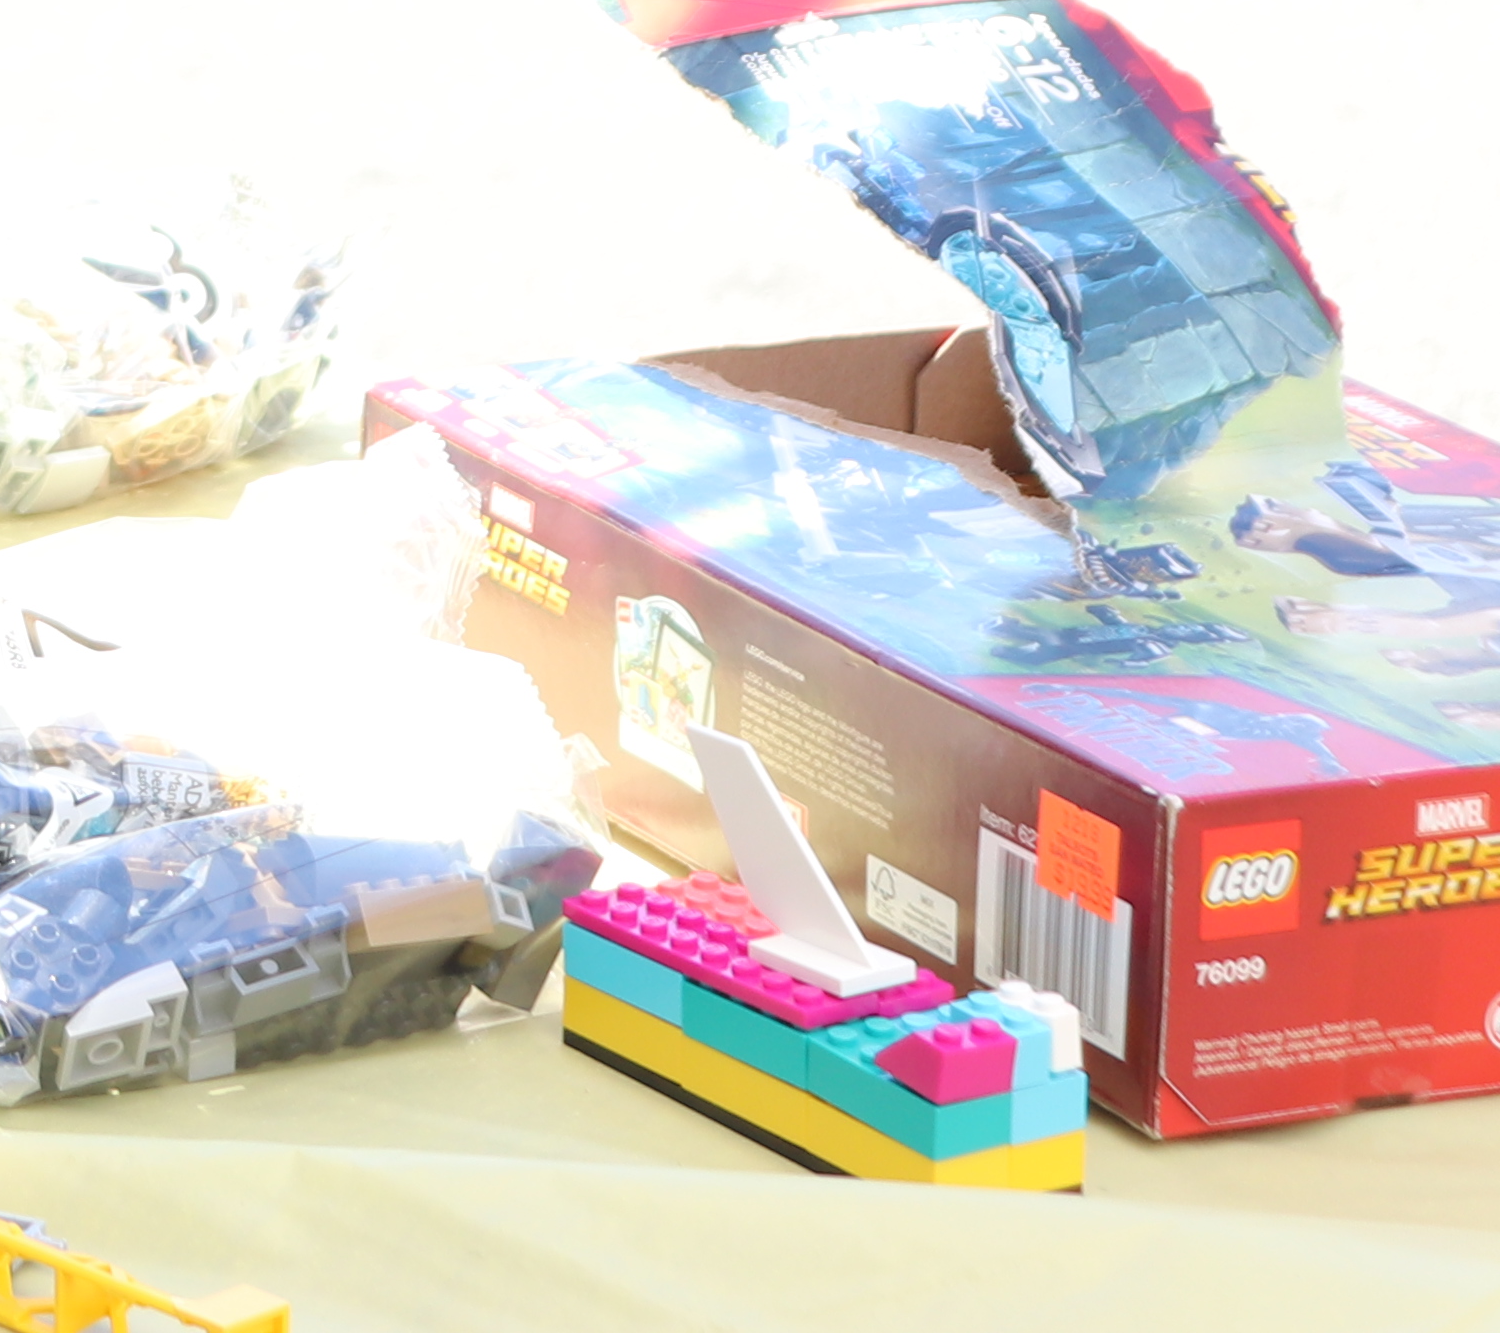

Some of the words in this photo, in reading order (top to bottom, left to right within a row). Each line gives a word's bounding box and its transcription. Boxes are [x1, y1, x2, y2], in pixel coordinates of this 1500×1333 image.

[980, 14, 1081, 105] 6-12
[1416, 797, 1488, 834] MARVEL
[1205, 851, 1295, 905] LEGO
[1194, 955, 1267, 986] 76099
